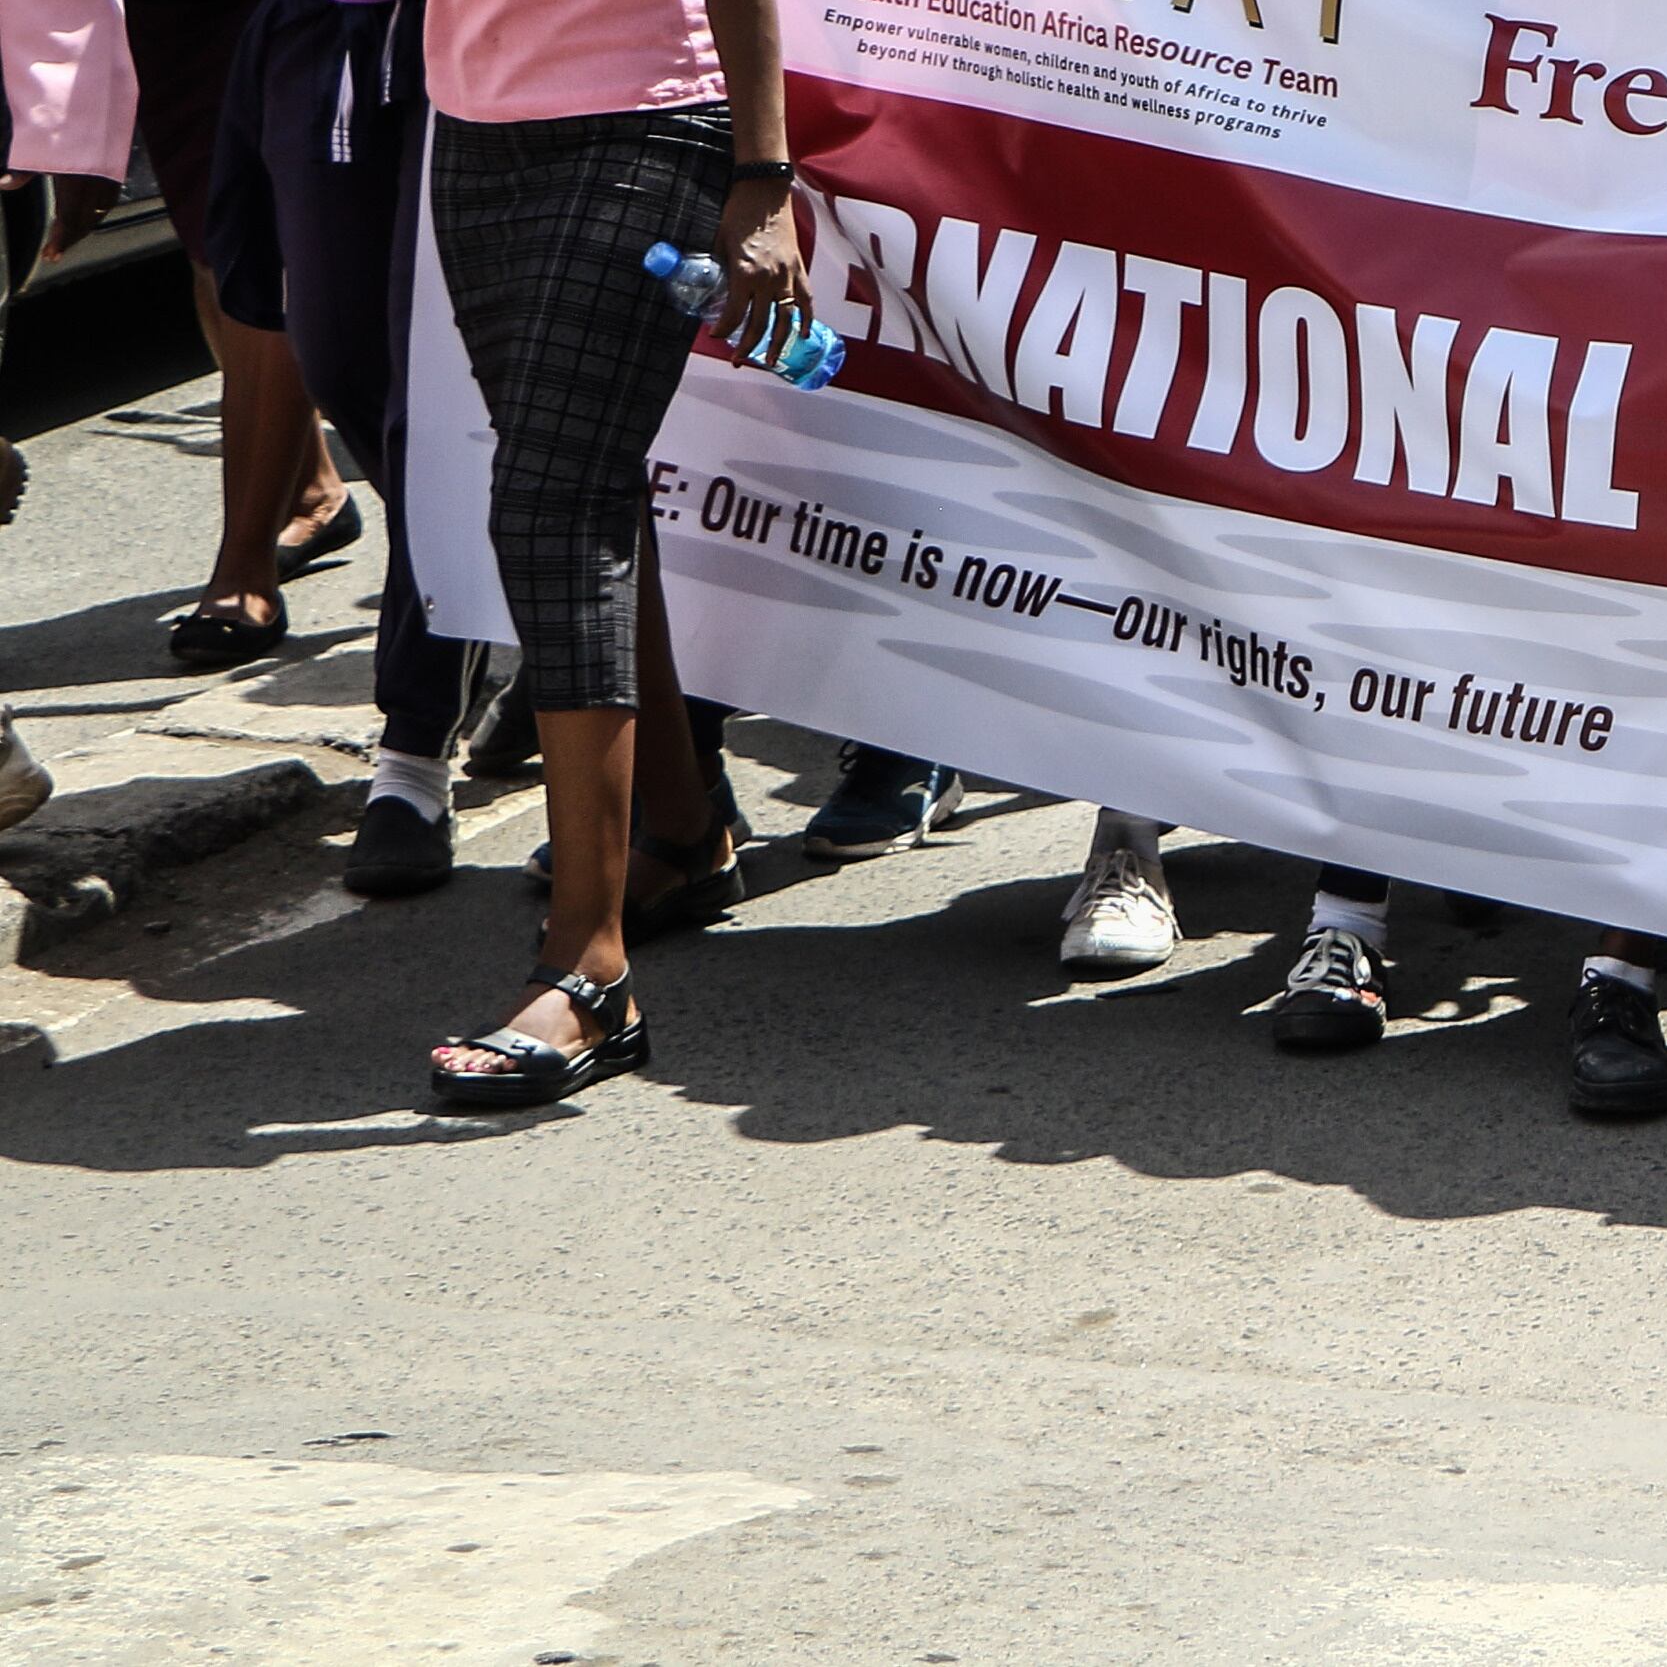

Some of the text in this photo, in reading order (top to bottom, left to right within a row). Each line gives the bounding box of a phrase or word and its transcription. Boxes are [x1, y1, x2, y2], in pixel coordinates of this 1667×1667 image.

[824, 7, 1328, 129] Empower vulnerable women, children and youth of Africa to thrive
[855, 37, 1282, 140] beyond HIV through holistic health and wellness programs
[1042, 8, 1108, 50] Africa
[1114, 27, 1252, 81] Resource
[1262, 56, 1339, 99] Team
[795, 184, 1641, 532] ERNATIONAL
[701, 475, 782, 545] Our
[790, 502, 887, 577] time
[900, 527, 939, 591] is
[1197, 616, 1325, 713] rights,
[1348, 666, 1435, 724] our
[1447, 672, 1616, 752] future
